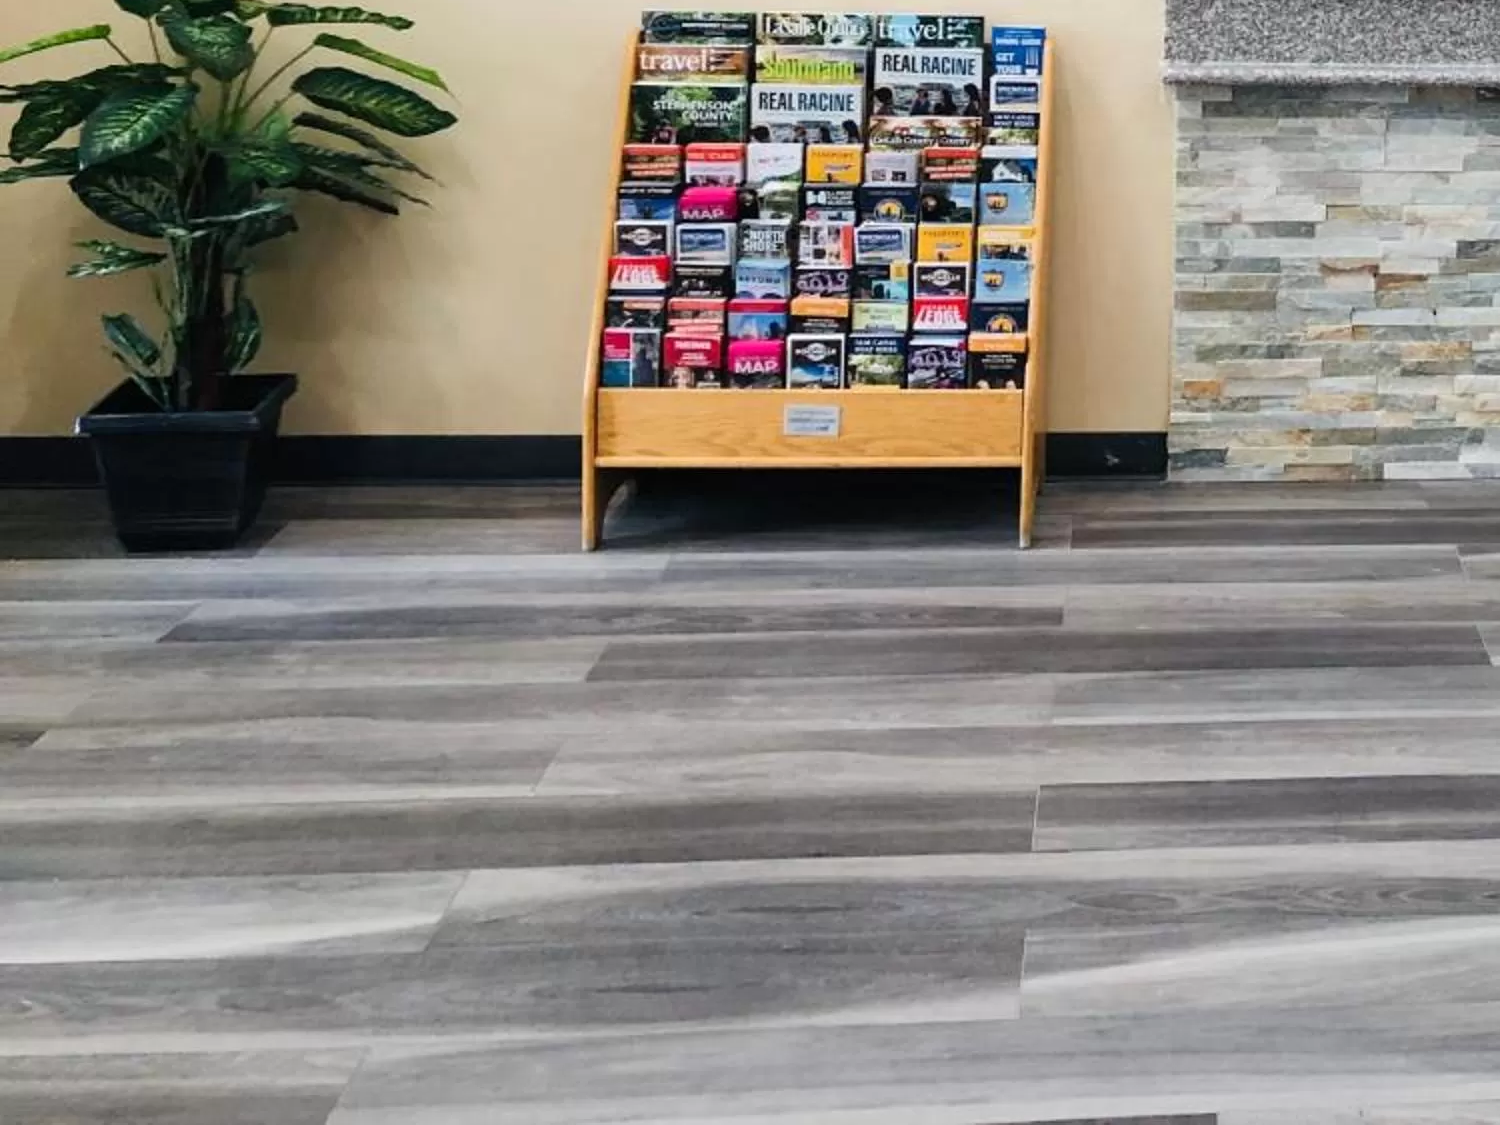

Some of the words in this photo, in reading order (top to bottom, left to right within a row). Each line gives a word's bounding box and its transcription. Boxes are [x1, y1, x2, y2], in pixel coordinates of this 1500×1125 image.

[640, 48, 707, 72] travel
[882, 54, 918, 74] REAL
[920, 54, 976, 76] RACINE
[759, 92, 796, 111] REAL
[797, 92, 855, 112] RACINE
[682, 111, 733, 121] COUNTY
[682, 208, 726, 220] MAP
[734, 361, 778, 374] MAP
